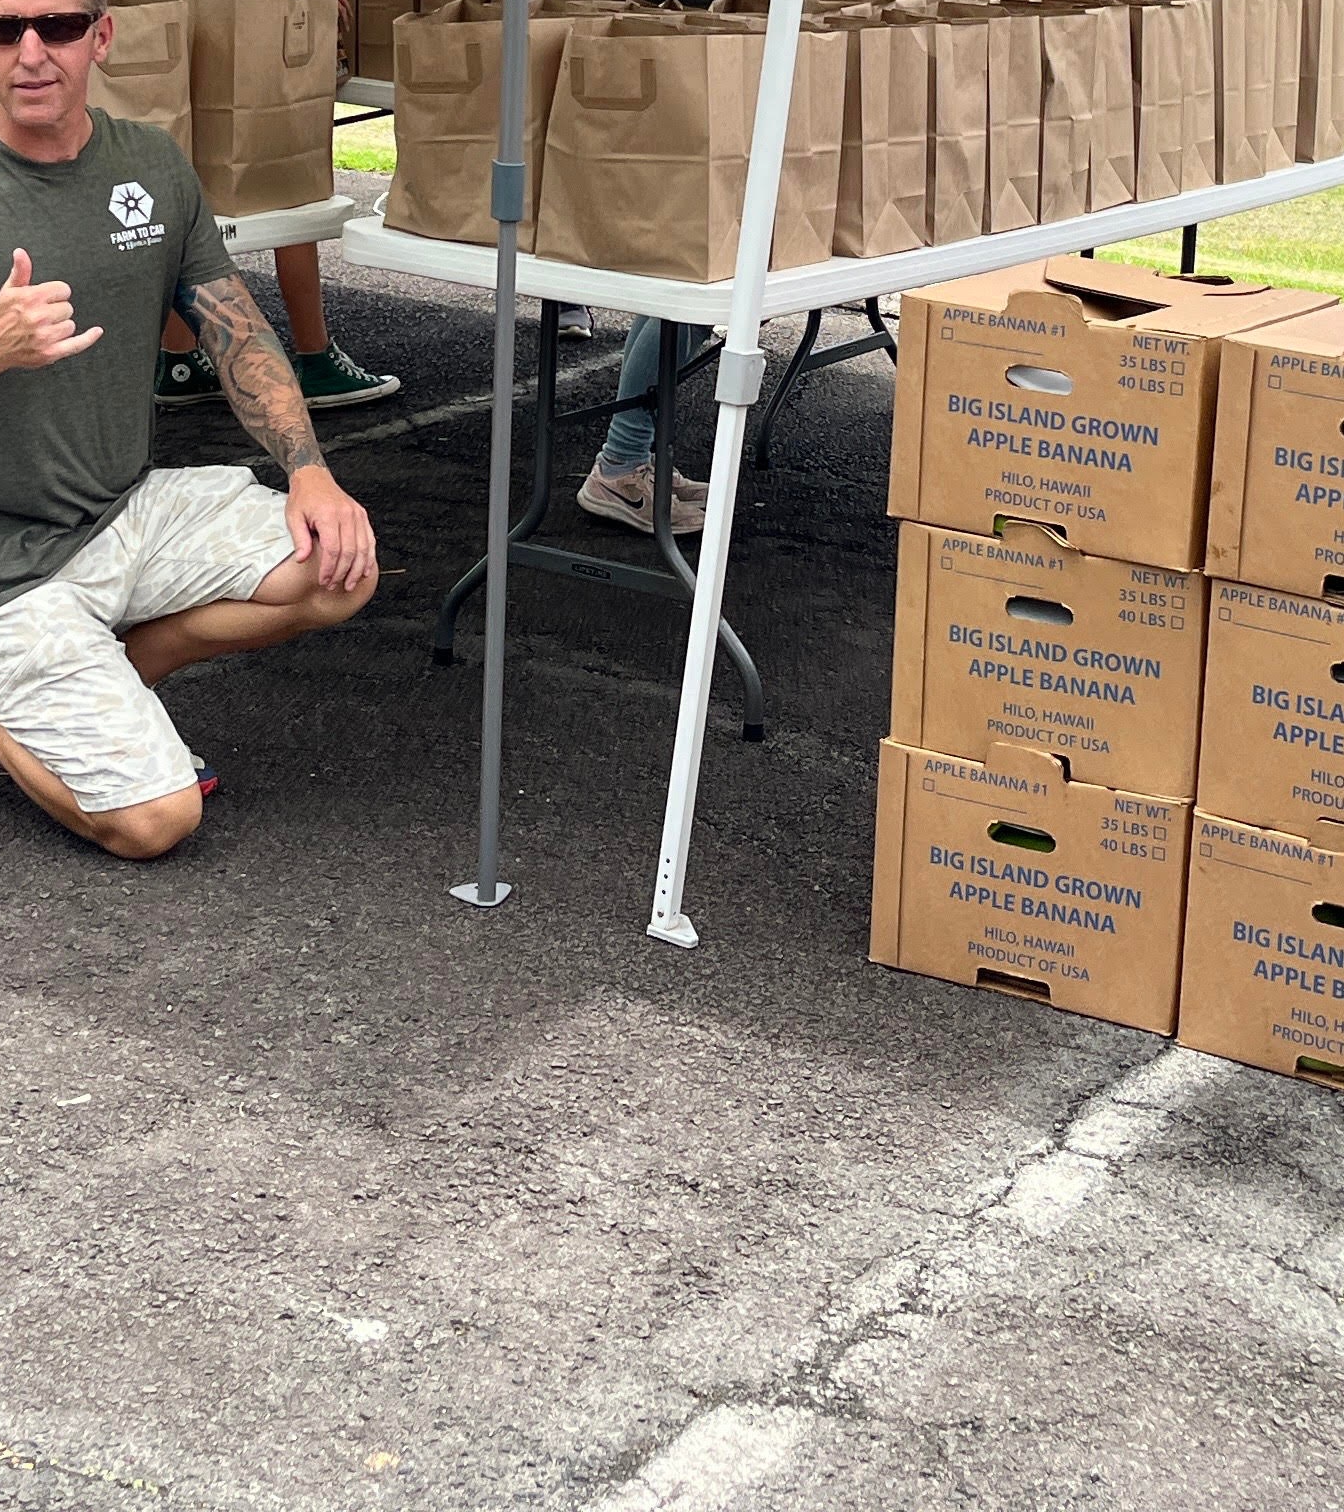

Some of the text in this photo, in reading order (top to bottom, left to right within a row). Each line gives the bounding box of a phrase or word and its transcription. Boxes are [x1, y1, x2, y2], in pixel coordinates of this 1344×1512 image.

[110, 229, 137, 245] FARM
[137, 227, 149, 239] TO
[944, 308, 1067, 337] APPLE BANANA #1
[1133, 335, 1190, 355] NET WT.
[1119, 355, 1167, 374] 35 LBS
[1270, 355, 1317, 374] APPLE
[1117, 376, 1167, 394] 40 LBS
[948, 395, 1159, 445] BIG ISLAND GROWN
[967, 428, 1134, 472] APPLE BANANA
[1274, 448, 1313, 472] BIG
[1001, 471, 1091, 498] HILO, HAWAII
[985, 488, 1107, 522] PRODUCT OF USA
[942, 538, 1064, 570] APPLE BANANA #1
[1131, 569, 1161, 585] NET
[1119, 589, 1168, 606] 35 LBS
[1220, 589, 1265, 608] APPLE
[1269, 598, 1332, 622] BANANA
[1118, 609, 1167, 628] 40 LBS
[948, 625, 1161, 679] BIG ISLAND GROWN
[968, 660, 1136, 705] APPLE BANANA
[1252, 685, 1290, 711] BIG
[1003, 703, 1095, 731] HILO, HAWAII
[987, 719, 1110, 754] PRODUCT OF USA
[924, 760, 1048, 796] APPLE BANANA #1
[1115, 798, 1171, 821] NET WT.
[1101, 818, 1149, 838] 35 LBS
[1100, 838, 1148, 858] 40 LBS
[1201, 824, 1334, 867] APPLE BANANA #1
[929, 847, 1142, 909] BIG ISLAND GROWN
[949, 882, 1115, 934] APPLE BANANA
[985, 927, 1075, 957] HILO, HAWAII
[1233, 922, 1271, 948] BIG
[968, 941, 1090, 982] PRODUCT OF USA
[1252, 960, 1327, 994] APPLE
[1290, 1008, 1329, 1030] HILO,
